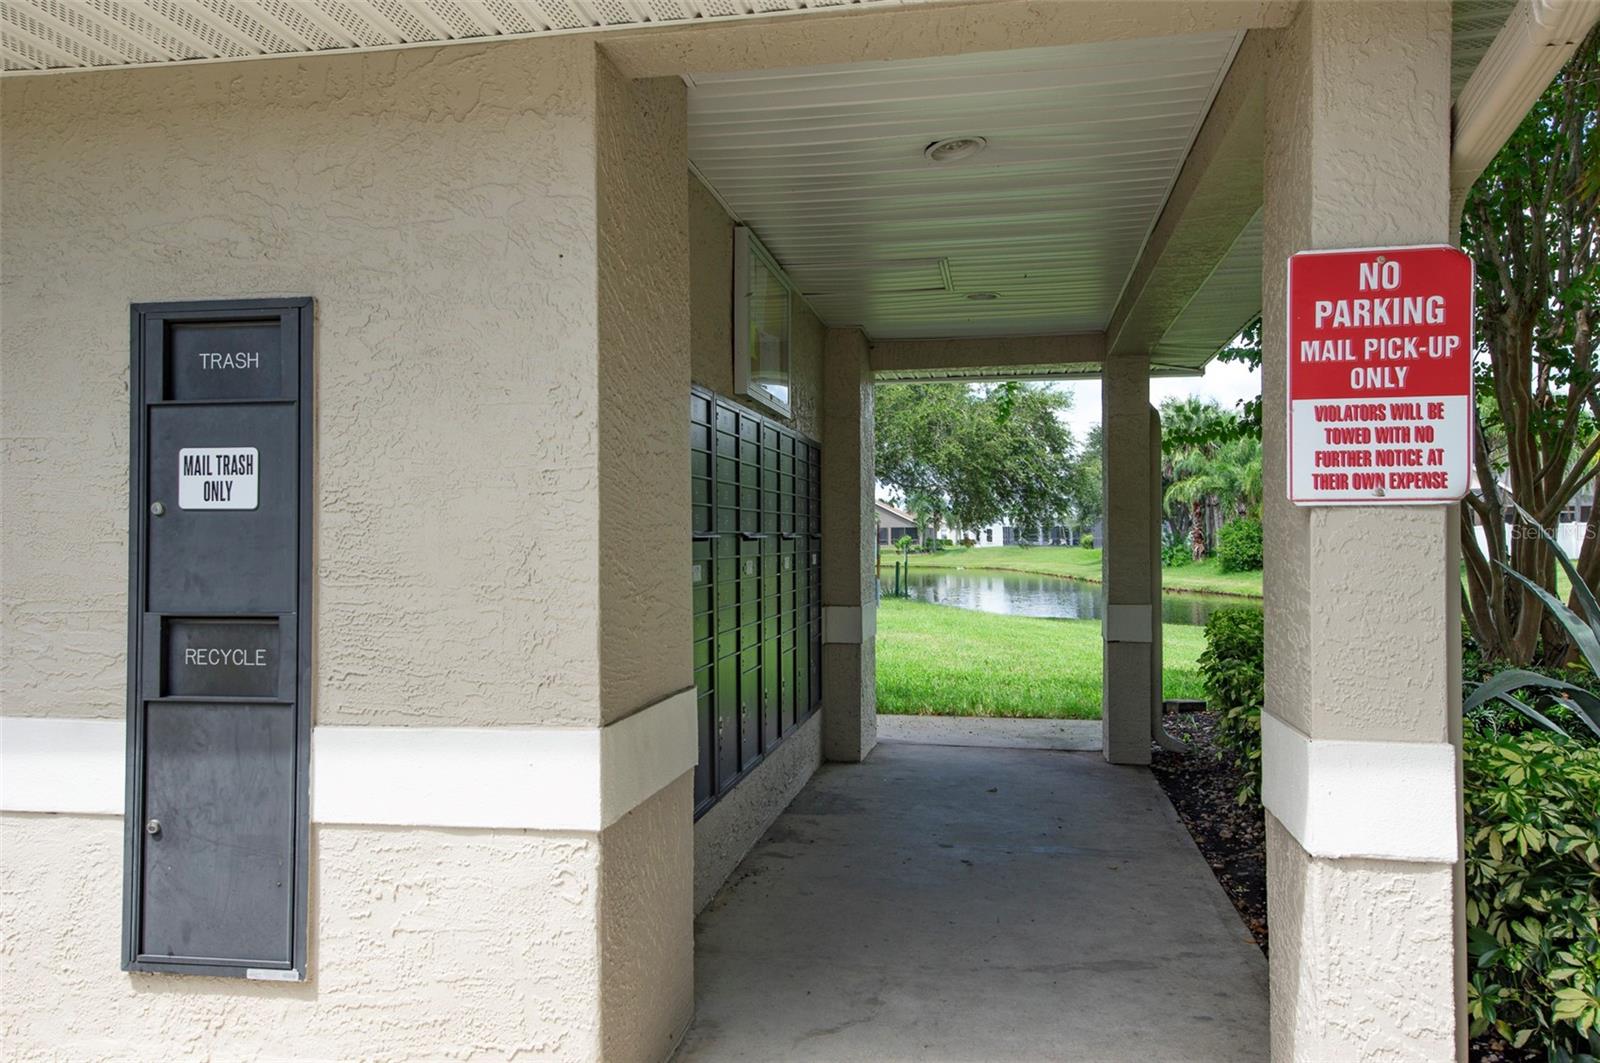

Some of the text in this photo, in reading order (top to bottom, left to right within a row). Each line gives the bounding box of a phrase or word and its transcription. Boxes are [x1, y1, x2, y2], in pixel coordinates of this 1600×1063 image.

[1359, 261, 1400, 290] NO
[1315, 295, 1445, 328] PARKING
[1301, 335, 1460, 362] MAIL PICK-UP
[199, 352, 259, 370] TRASH
[1350, 366, 1408, 389] ONLY
[1314, 402, 1445, 422] VIOLATORS WILL BE
[1324, 425, 1434, 445] TOWED WITH NO
[184, 454, 253, 476] MAIL TRASH
[1315, 448, 1445, 468] FURTHER NOTICE AT
[203, 480, 233, 502] ONLY
[1312, 471, 1448, 490] THEIR OWN EXPENSE
[185, 648, 267, 666] RECYCLE
